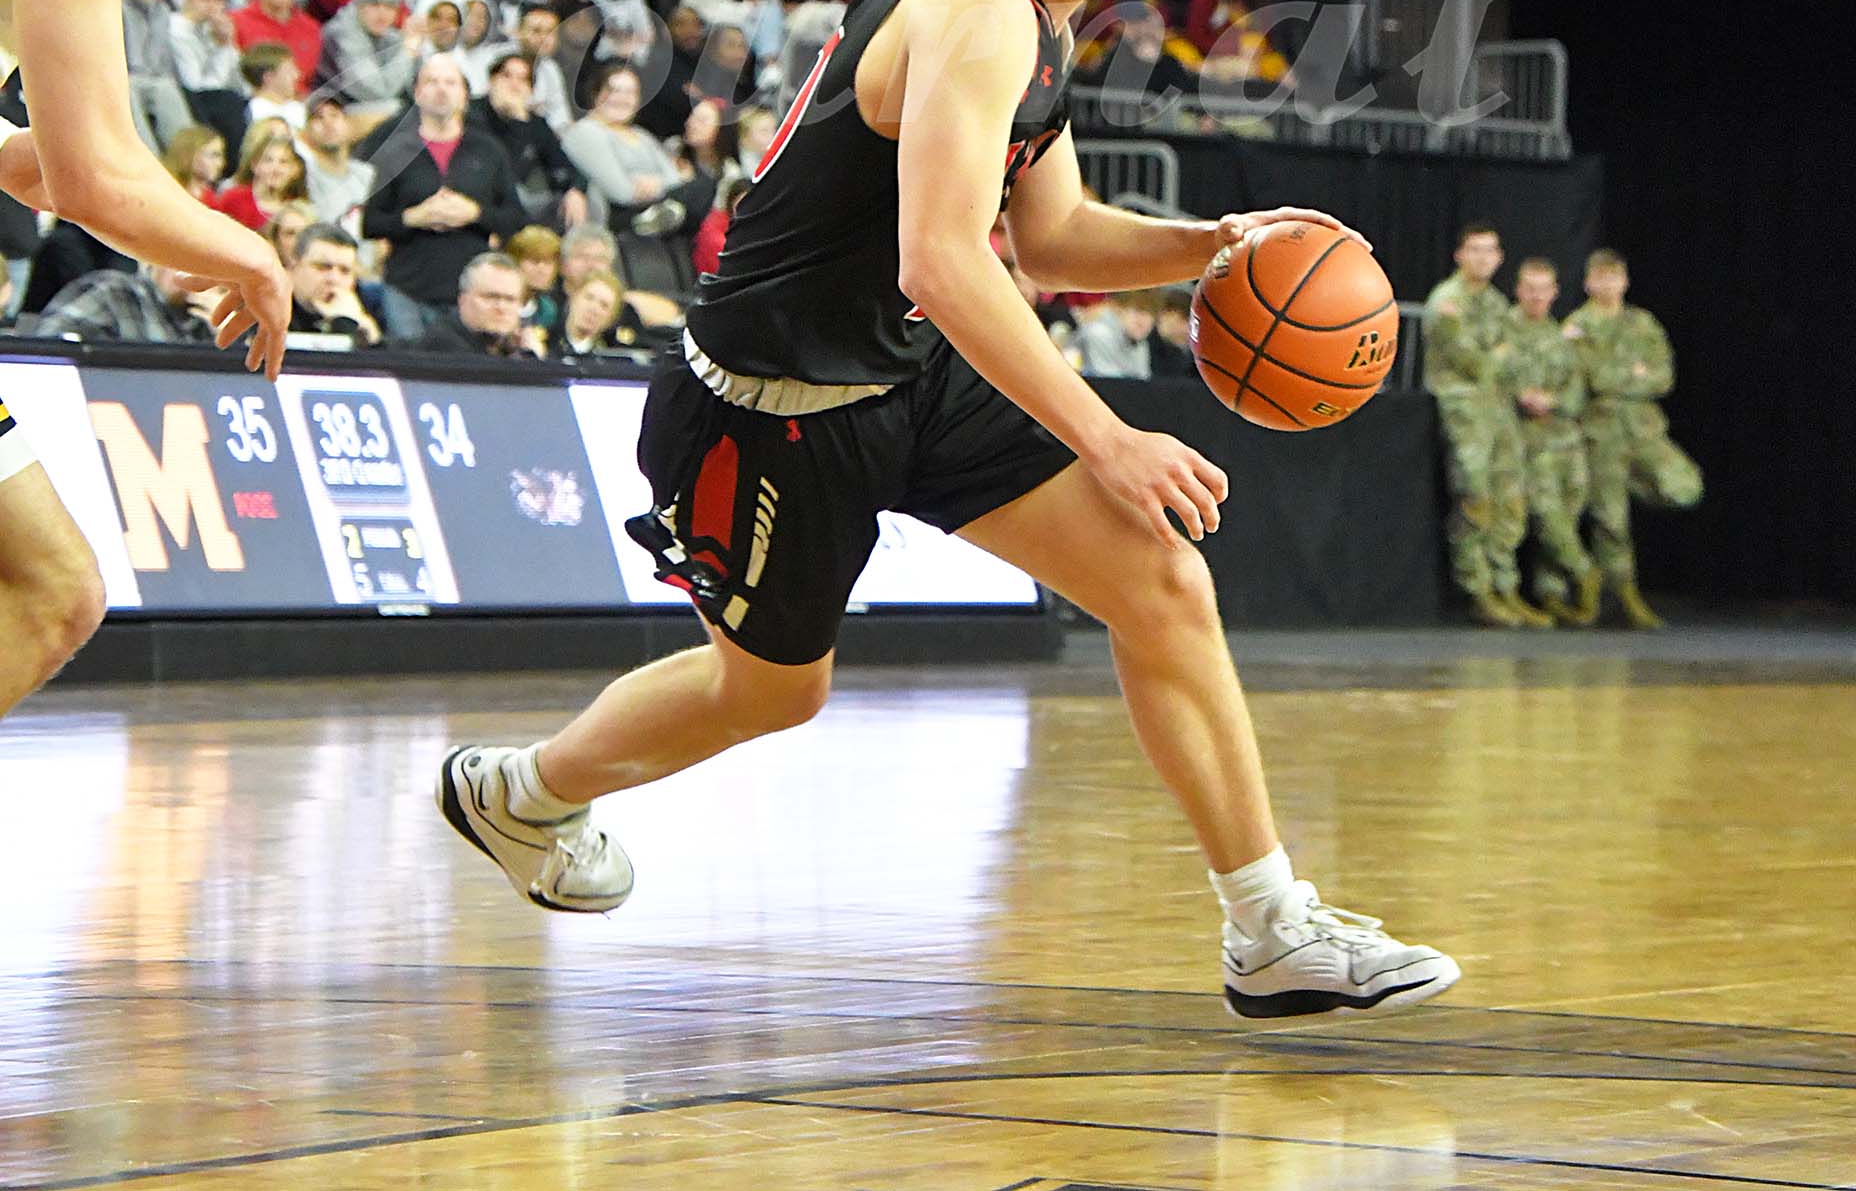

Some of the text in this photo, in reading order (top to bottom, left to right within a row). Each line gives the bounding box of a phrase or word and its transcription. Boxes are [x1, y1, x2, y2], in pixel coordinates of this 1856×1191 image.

[217, 395, 278, 463] 35
[312, 402, 390, 459] 38.3
[418, 402, 476, 468] 34
